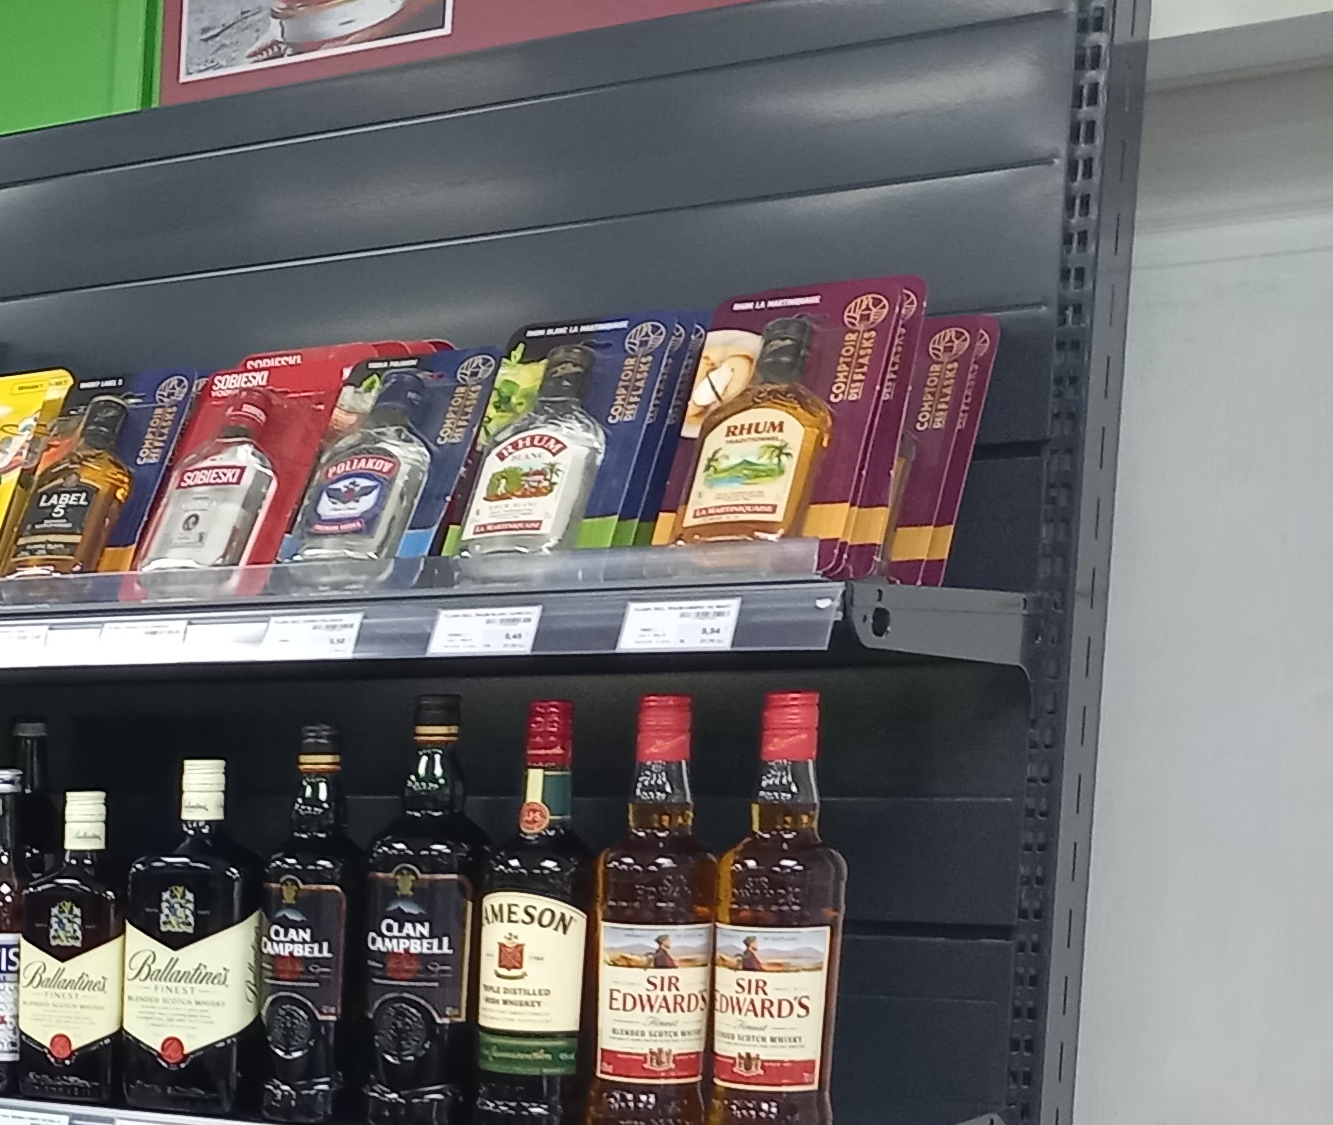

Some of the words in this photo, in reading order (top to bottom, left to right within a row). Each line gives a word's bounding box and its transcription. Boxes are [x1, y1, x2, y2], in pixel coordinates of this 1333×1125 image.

[853, 330, 877, 384] FLASKS
[830, 332, 859, 403] COMPTOIR
[213, 371, 269, 390] SOBIESKI
[937, 361, 959, 414] FLASKS
[608, 358, 636, 424] COMPTOIR
[916, 361, 942, 431] COMPTOIR
[137, 406, 164, 465] COMPTOIR
[725, 420, 784, 438] RHUM
[499, 435, 567, 461] RHUM
[181, 468, 241, 486] SOBIESKI
[326, 456, 394, 479] POLIAKOV
[40, 492, 88, 508] LABEL
[52, 505, 66, 518] 5
[695, 508, 706, 516] LA
[381, 918, 430, 938] CLAN
[481, 902, 574, 936] AMESON
[270, 926, 311, 942] CLAN
[367, 931, 453, 954] CAMPBELL
[262, 937, 332, 958] CAMPBELL
[23, 960, 107, 994] Ballantine's
[127, 949, 229, 988] Ballantine's
[154, 985, 196, 995] FINEST
[503, 987, 551, 997] DISTILLED
[646, 975, 680, 992] SIR
[735, 978, 768, 996] SIR
[45, 992, 80, 1000] FINEST
[163, 997, 193, 1005] SCOTCH
[507, 997, 542, 1008] WHISKEY
[714, 990, 810, 1019] EDWARD'S
[737, 1032, 767, 1042] SCOTCH
[770, 1035, 802, 1044] WHISKY
